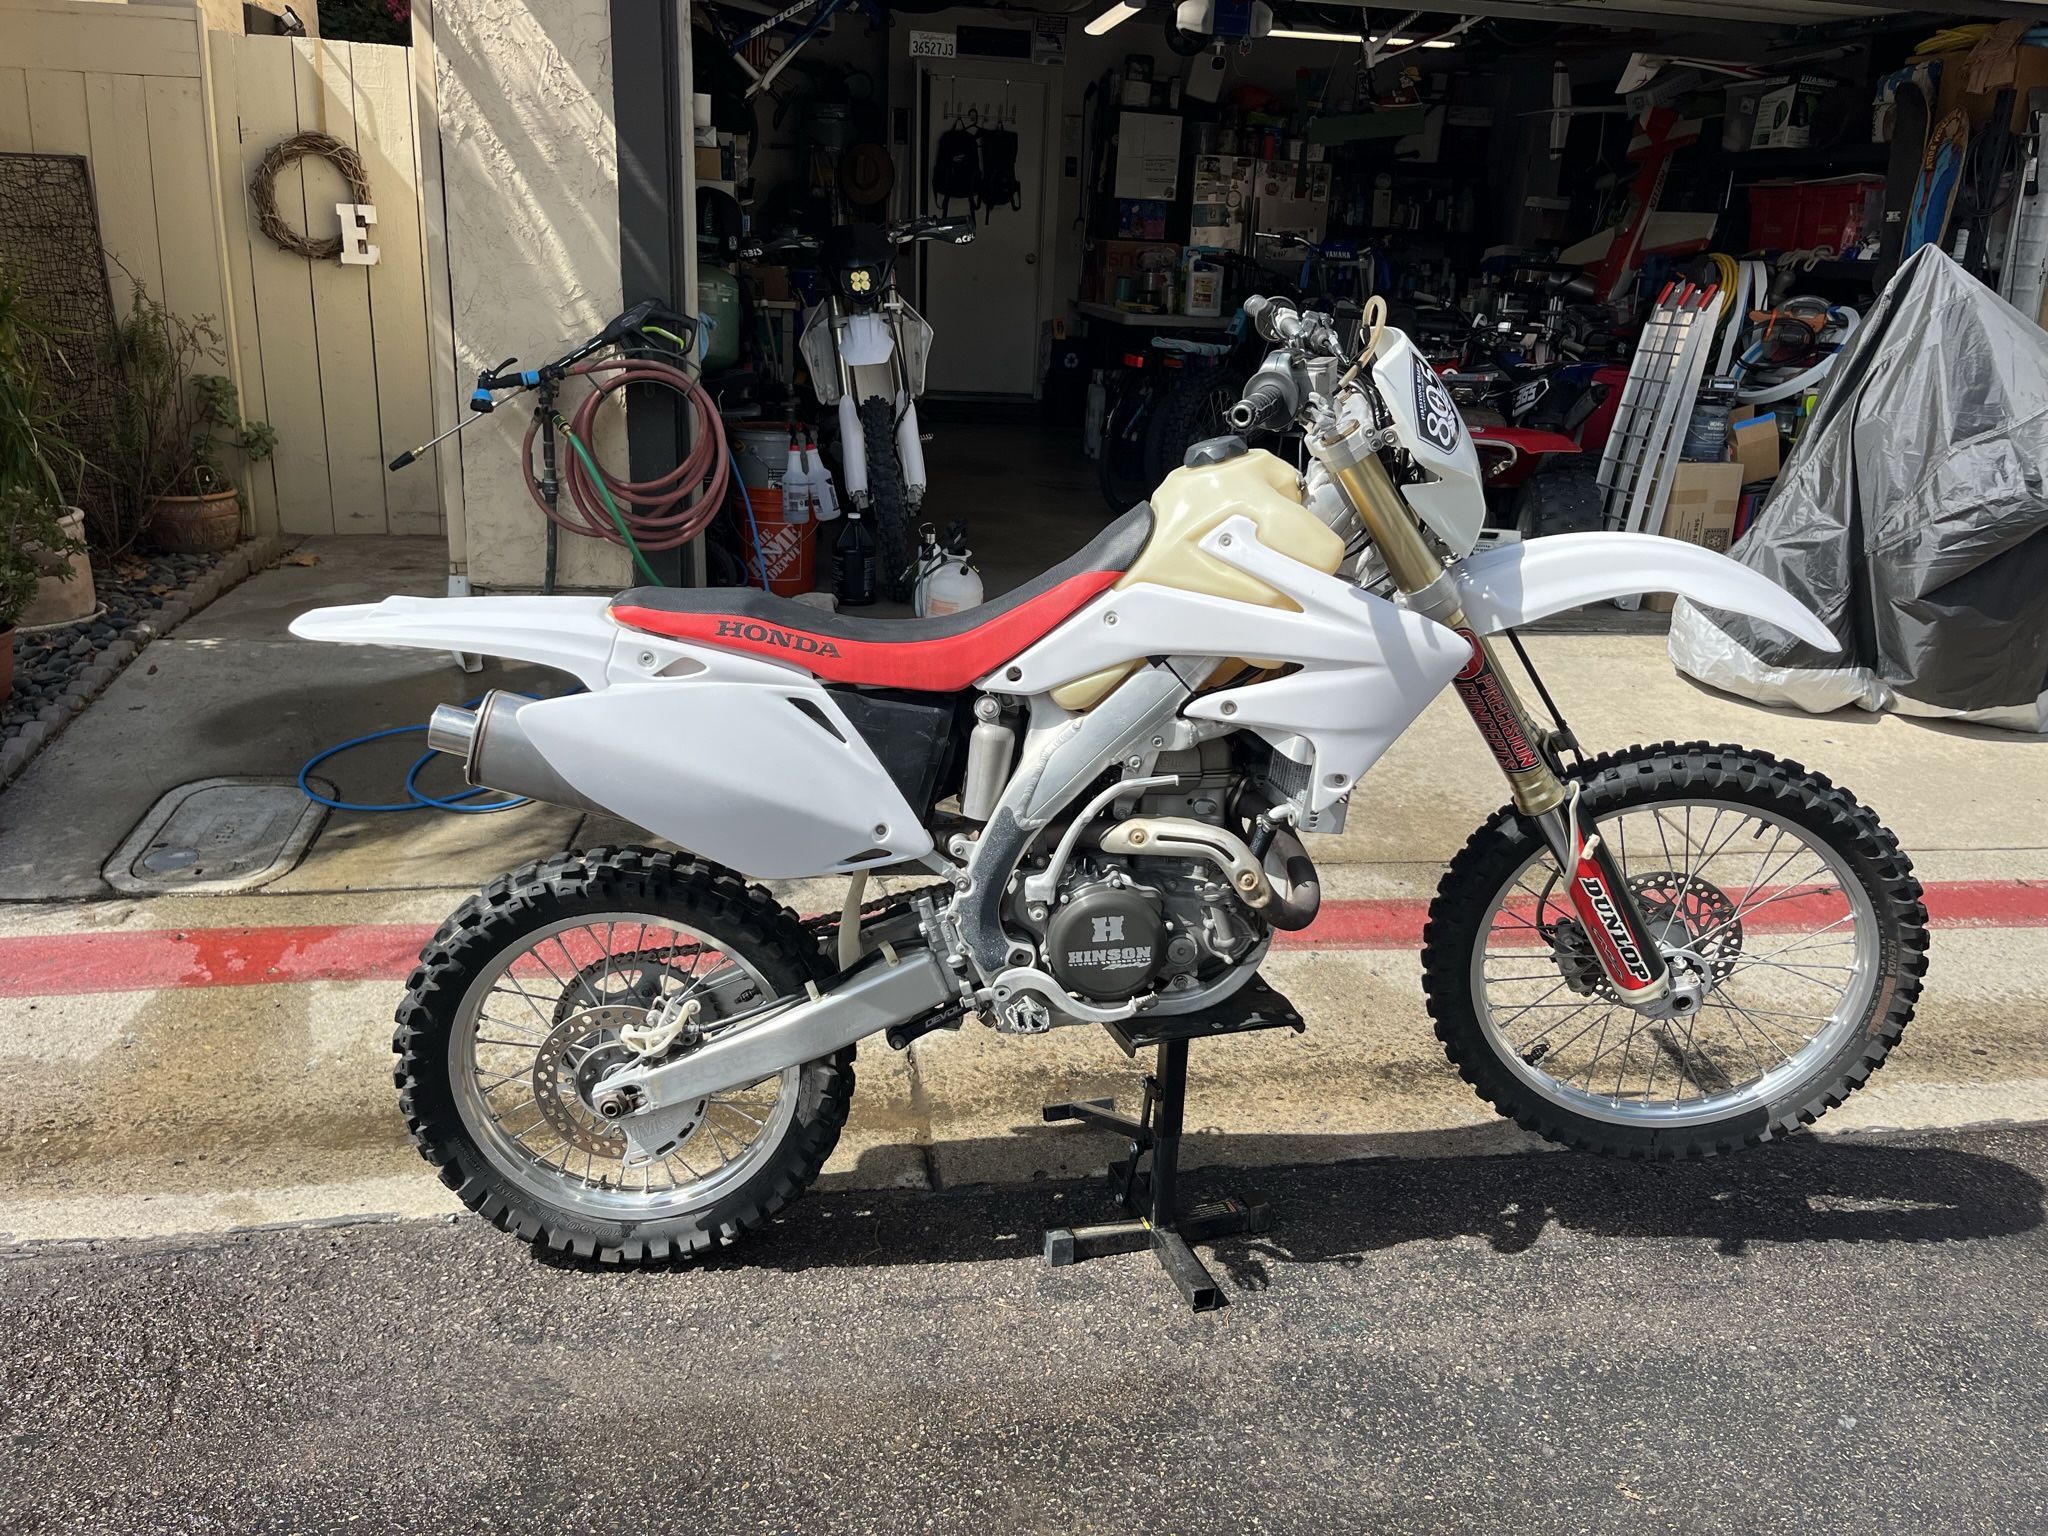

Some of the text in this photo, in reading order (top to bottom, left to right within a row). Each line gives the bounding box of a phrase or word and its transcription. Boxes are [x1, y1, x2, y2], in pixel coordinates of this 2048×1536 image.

[912, 40, 954, 56] 36527J3
[336, 203, 381, 265] E
[1325, 250, 1351, 259] YAMAHA
[1418, 359, 1451, 446] 805
[766, 542, 803, 580] DEPOT
[715, 620, 842, 658] HONDA
[1459, 682, 1519, 770] CONCEPTS
[1475, 672, 1538, 768] PRECISION
[1091, 915, 1124, 942] H
[1578, 877, 1652, 982] DUNLOP
[1067, 946, 1151, 964] HINSON
[1887, 939, 1898, 976] KENDA
